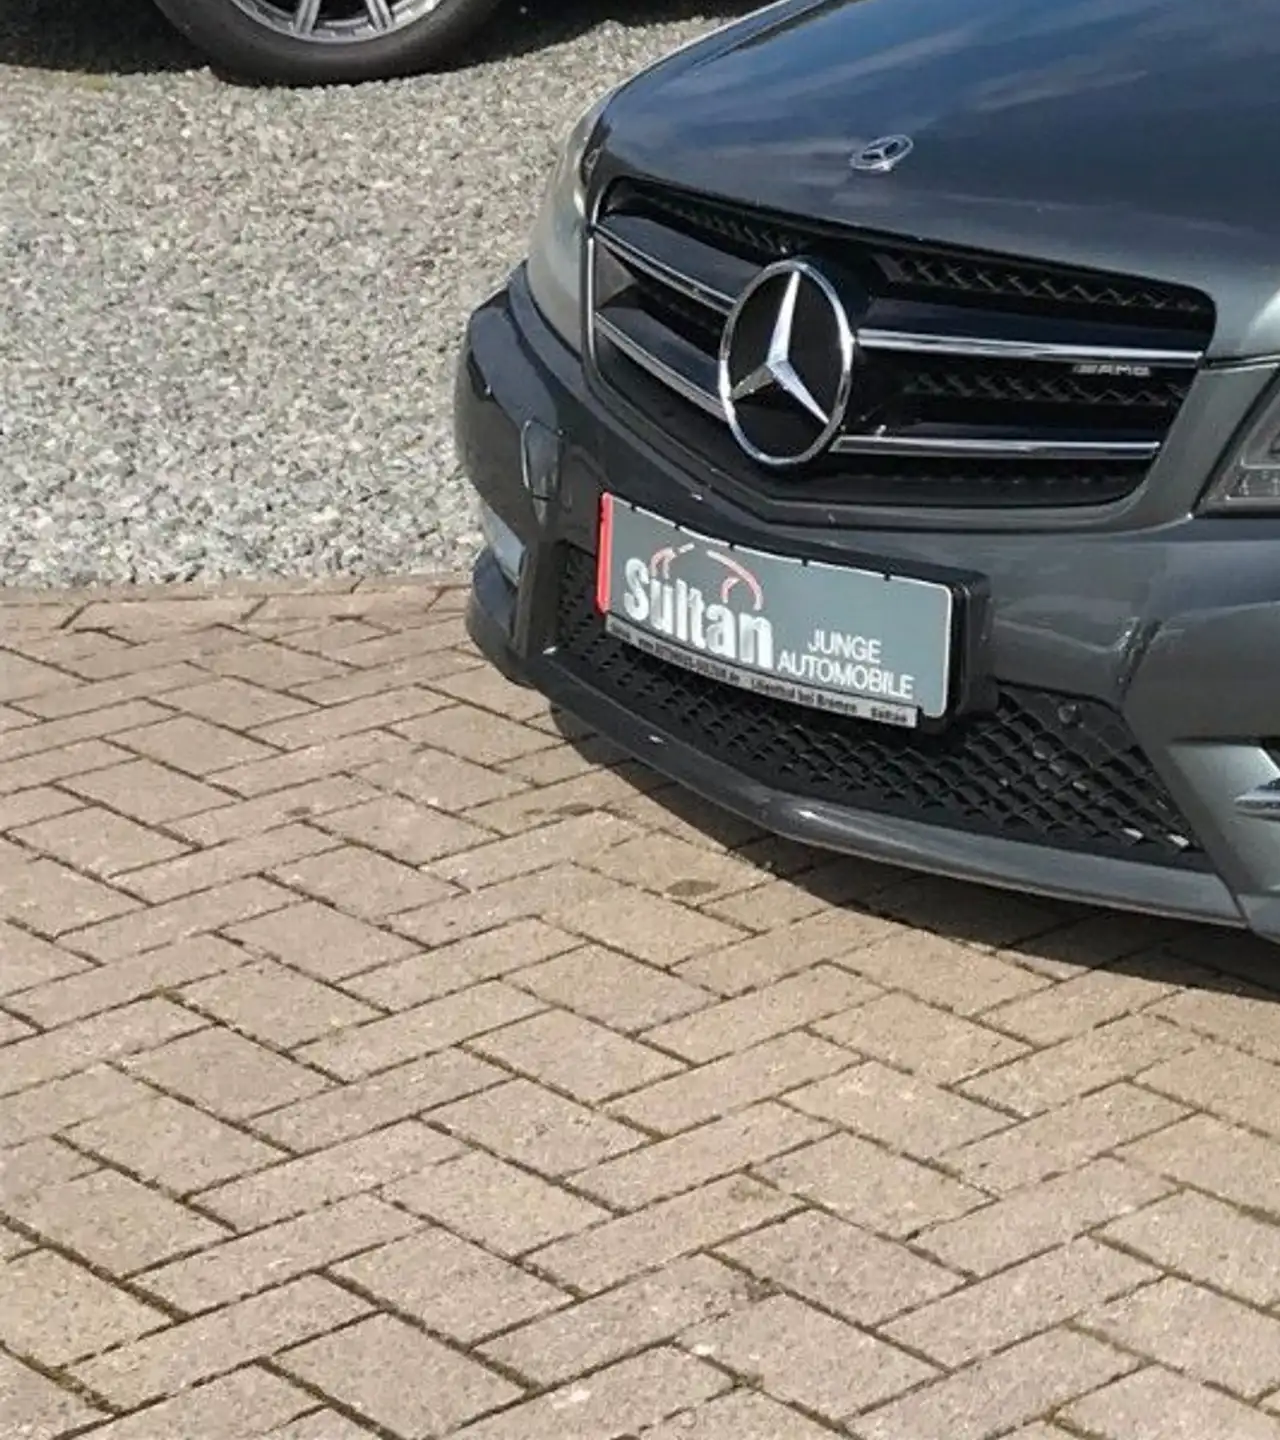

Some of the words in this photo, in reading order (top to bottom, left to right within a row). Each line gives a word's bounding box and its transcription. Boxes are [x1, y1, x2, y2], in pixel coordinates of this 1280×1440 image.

[623, 557, 774, 670] Sultan
[807, 629, 882, 665] JUNGE
[777, 649, 916, 700] AUTOMOBILE
